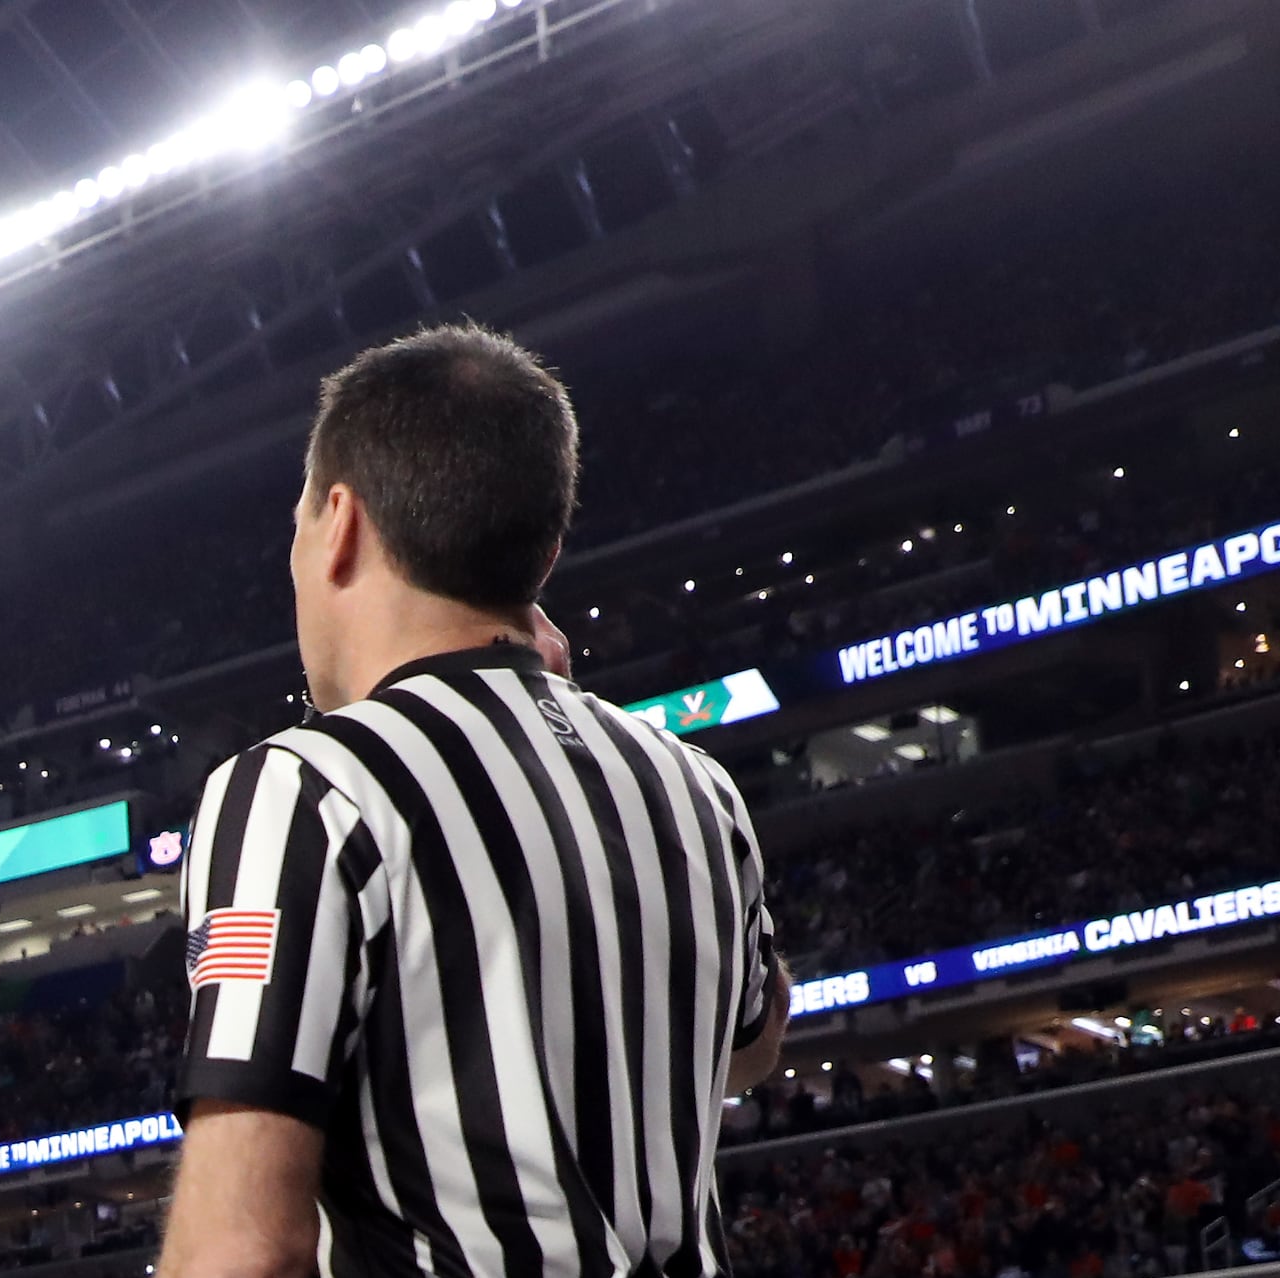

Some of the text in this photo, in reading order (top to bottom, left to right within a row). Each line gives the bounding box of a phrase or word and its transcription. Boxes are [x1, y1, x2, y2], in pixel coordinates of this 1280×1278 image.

[838, 613, 979, 684] WELCOME
[983, 606, 1013, 636] TO
[904, 961, 937, 987] VS
[972, 931, 1080, 972] VIRGINIA
[1083, 880, 1280, 952] CAVALIERS
[10, 1141, 27, 1161] TO
